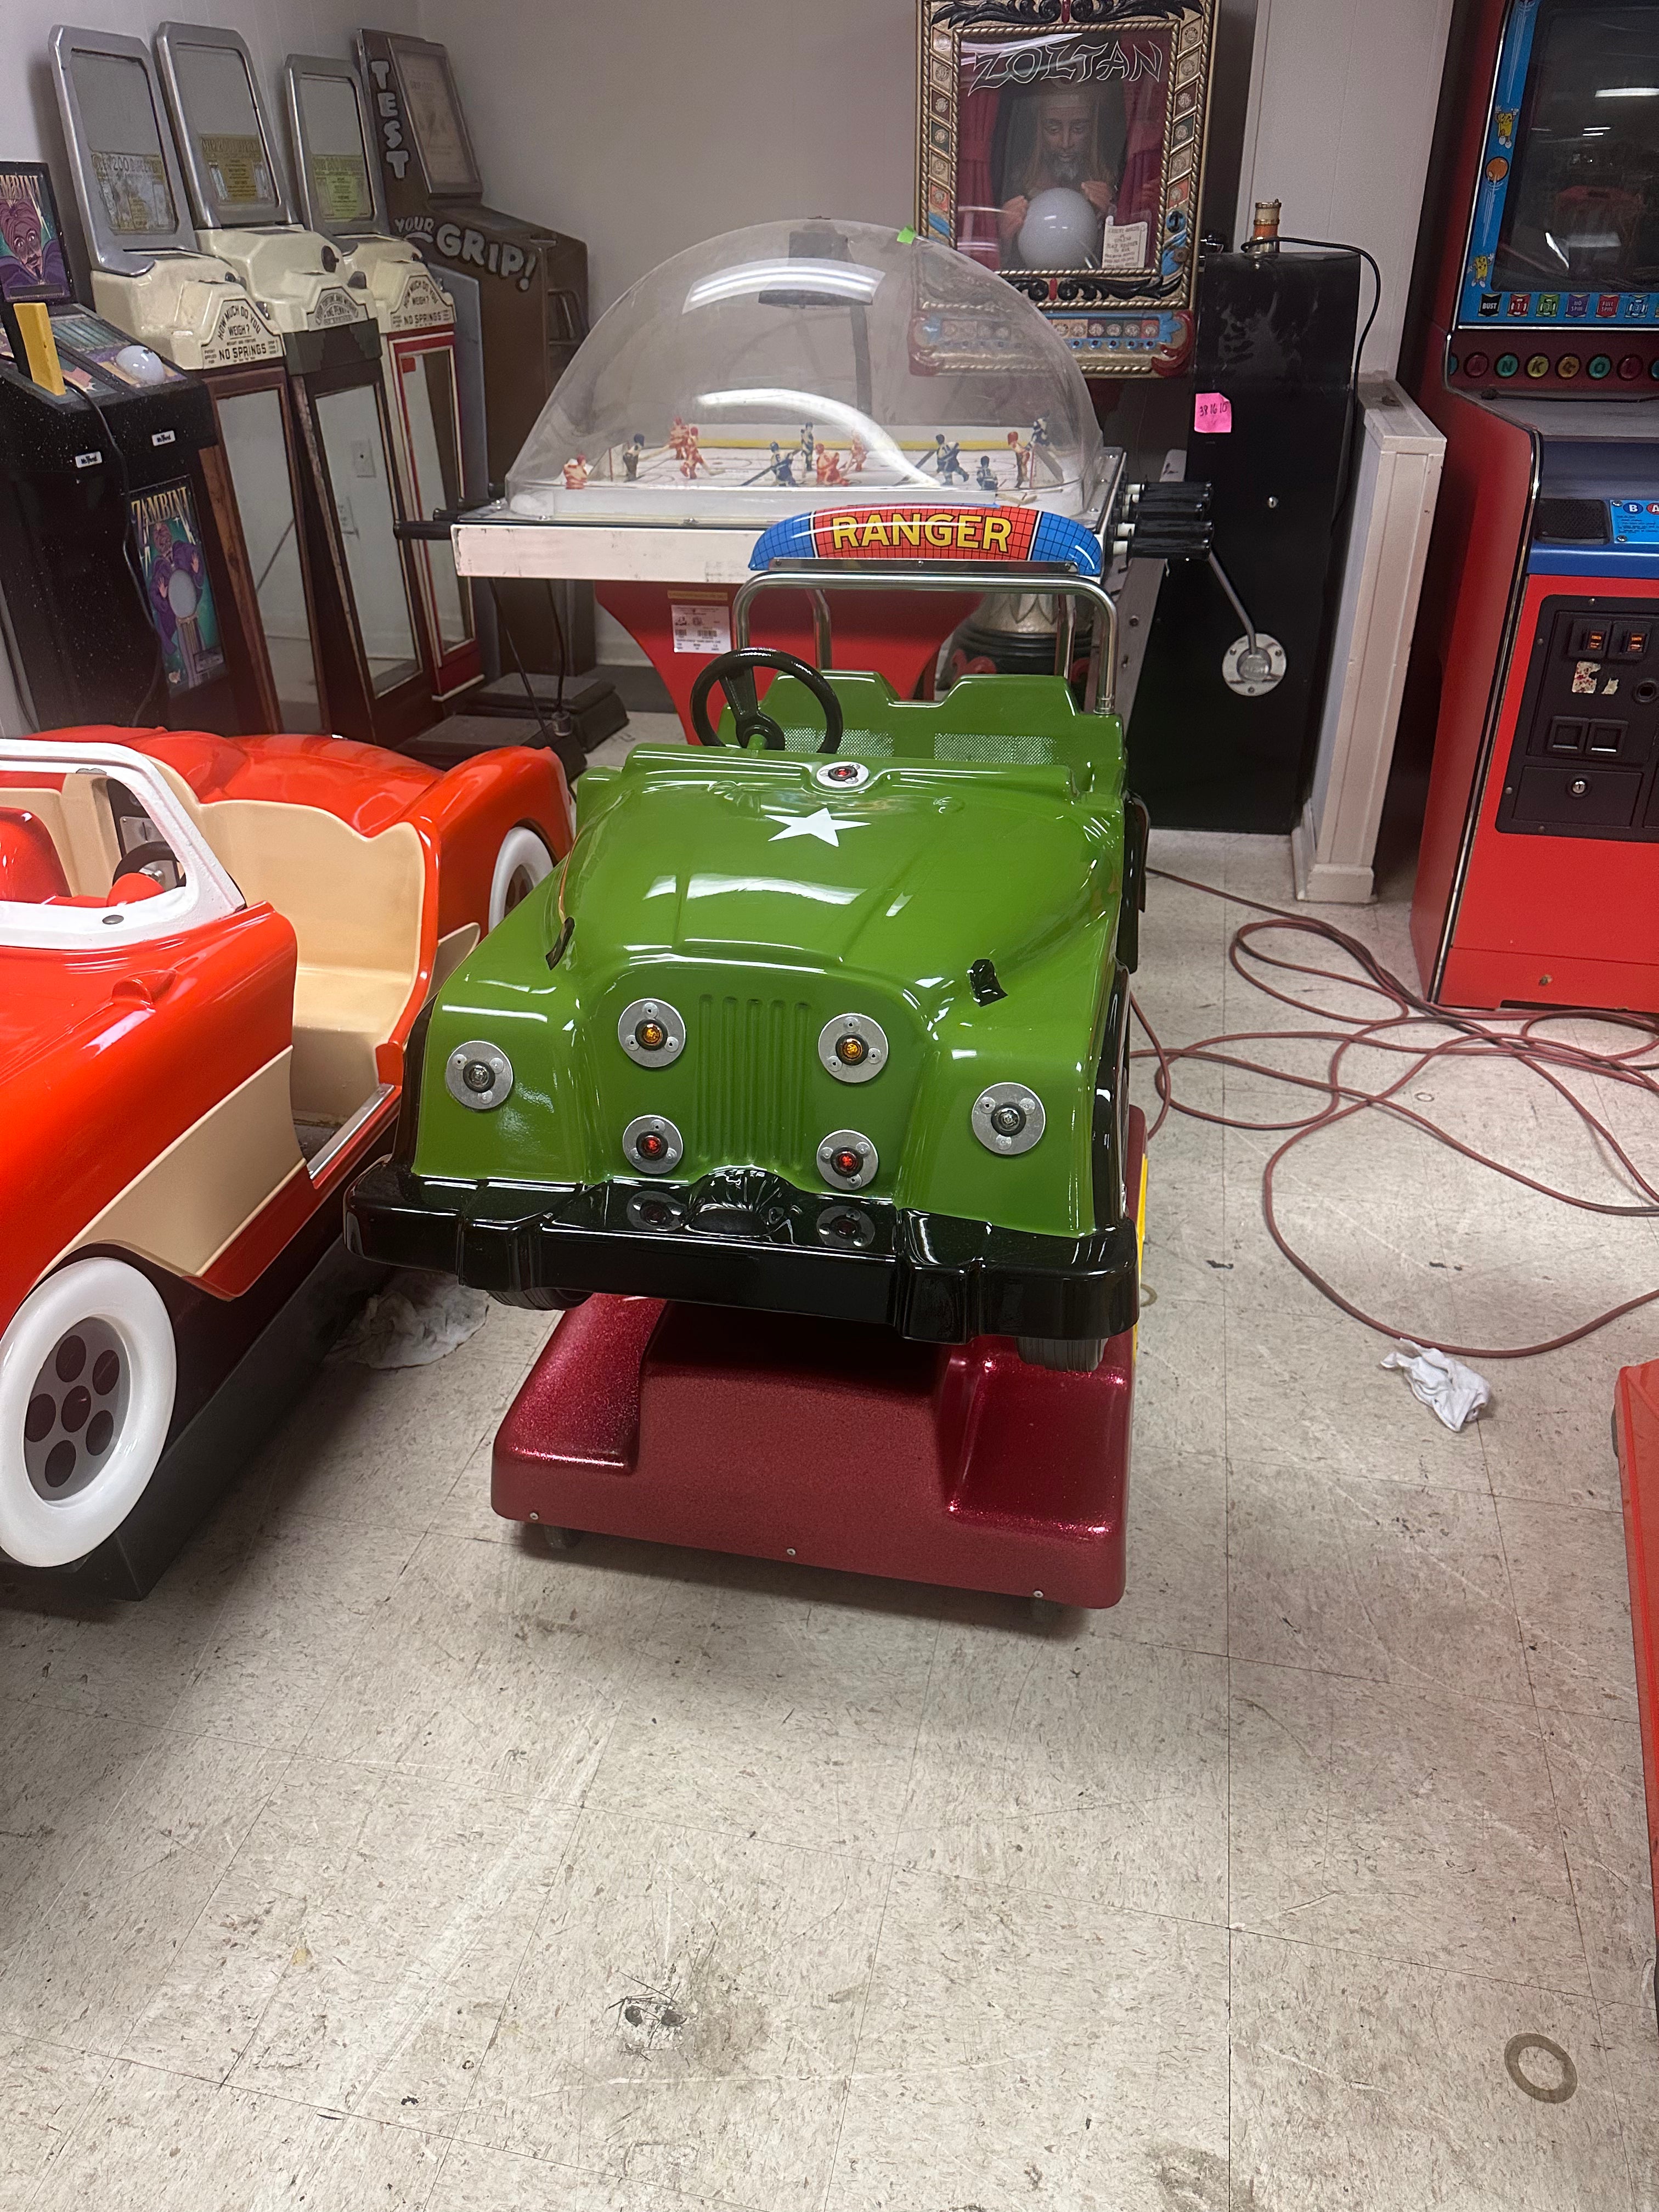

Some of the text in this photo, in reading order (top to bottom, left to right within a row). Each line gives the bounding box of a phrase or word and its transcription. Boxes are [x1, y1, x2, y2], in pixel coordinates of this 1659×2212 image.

[968, 40, 1163, 97] ZOLTAN
[371, 60, 409, 179] TEST
[394, 216, 537, 291] YOUR GRIP!
[217, 305, 261, 341] HOW MUCH DO YOU
[404, 315, 413, 325] NO
[415, 311, 441, 323] SPRINGS
[219, 348, 230, 361] NO
[232, 343, 267, 358] SPRINGS
[1502, 360, 1514, 372] N
[1531, 360, 1545, 374] K
[1210, 403, 1217, 414] 16
[131, 487, 193, 528] ZAMBINI
[1629, 504, 1638, 512] B
[831, 512, 1013, 554] RANGER
